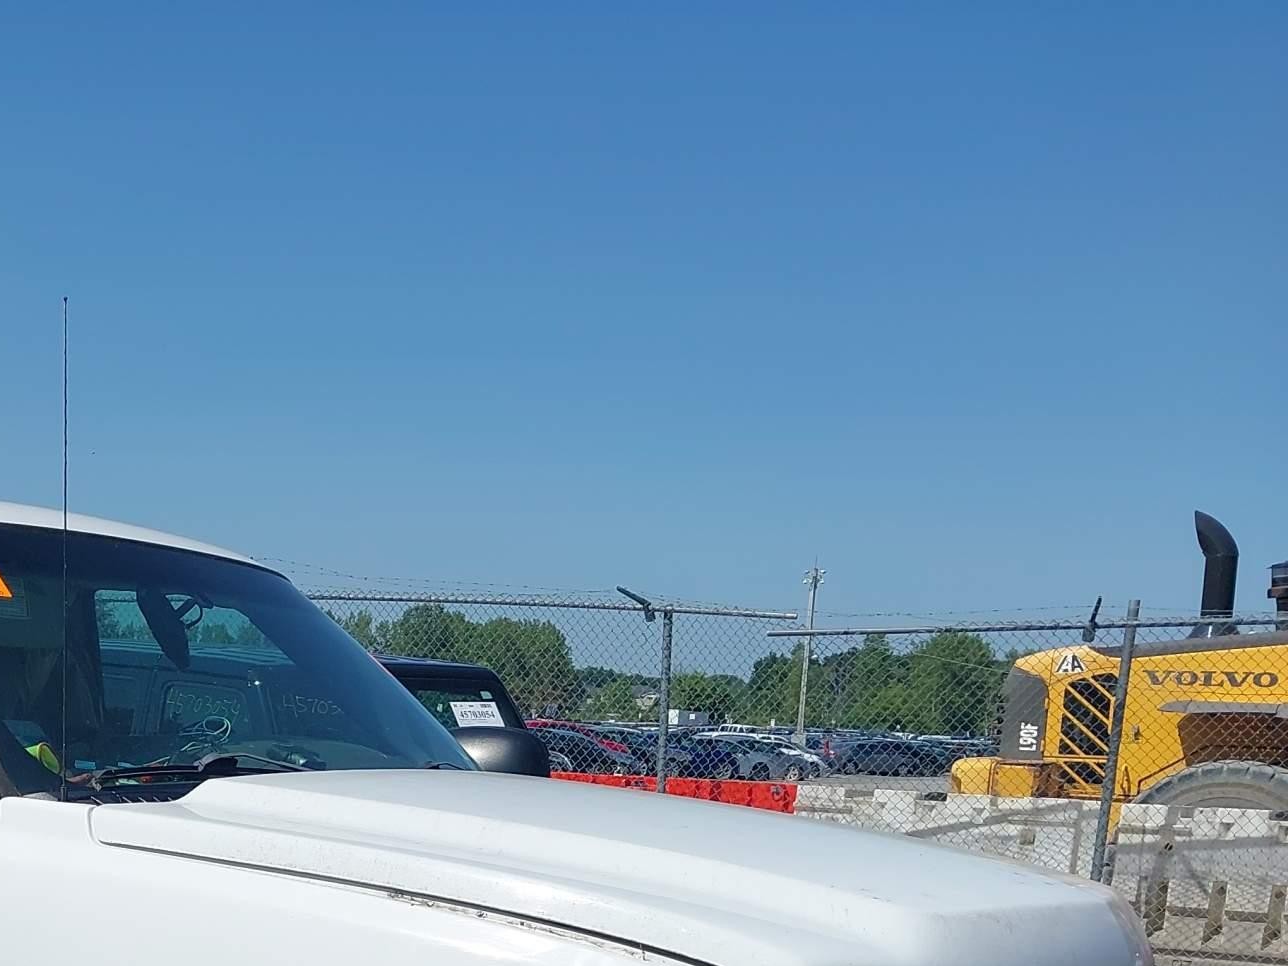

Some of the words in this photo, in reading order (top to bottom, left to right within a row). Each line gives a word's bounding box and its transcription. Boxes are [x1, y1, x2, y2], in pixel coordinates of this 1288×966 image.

[1143, 670, 1279, 687] VOLVO
[460, 710, 496, 719] 45703054
[1019, 722, 1039, 751] L90F
